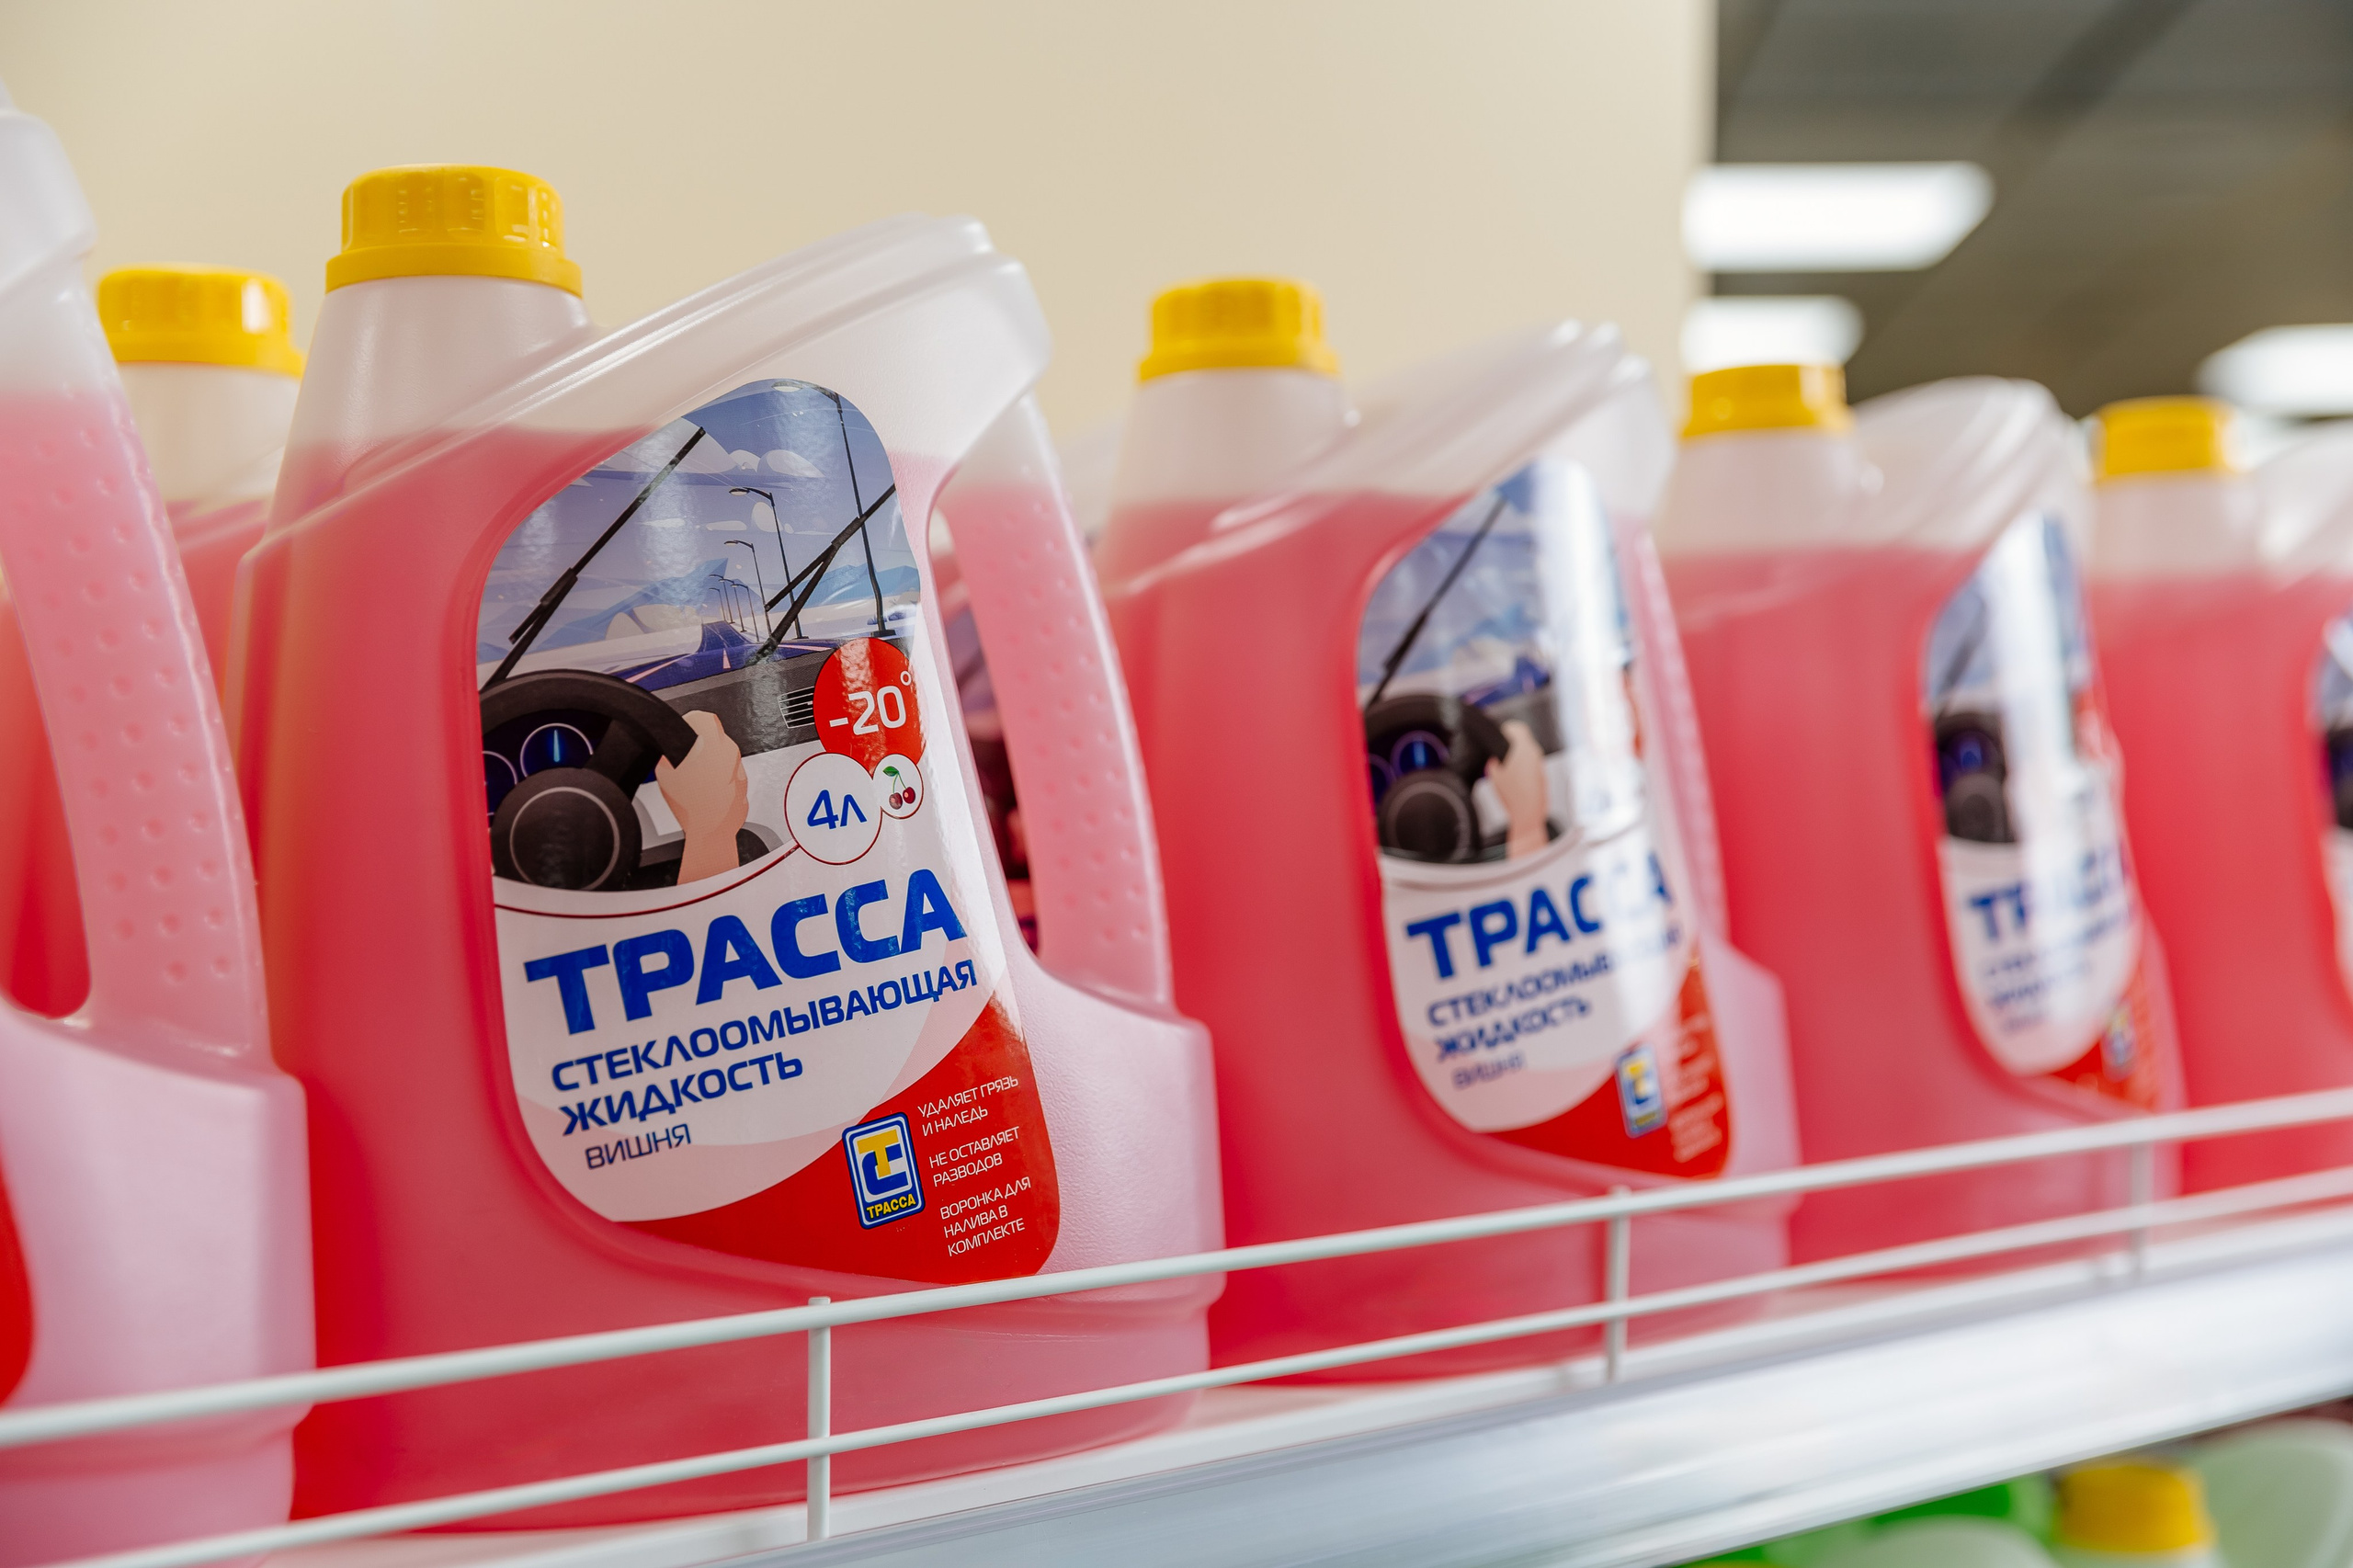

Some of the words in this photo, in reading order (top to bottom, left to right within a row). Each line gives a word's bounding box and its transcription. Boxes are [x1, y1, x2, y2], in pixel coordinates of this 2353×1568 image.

[524, 869, 967, 1035] ТРАССА
[551, 960, 977, 1091] СТЕКЛООМЫВАЮЩАЯ
[561, 1051, 802, 1136] ЖИДКОСТЬ
[917, 1087, 977, 1118] УДАЛЯЕТ
[980, 1074, 1018, 1098] ГРЯЗЬ
[922, 1123, 933, 1137] И
[935, 1106, 988, 1132] НАЛЕДЬ
[585, 1123, 691, 1169] ВИШНЯ
[928, 1151, 949, 1168] НЕ
[949, 1126, 1020, 1157] ОСТАВЛЯЕТ
[933, 1153, 1003, 1187] РАЗВОДОВ
[867, 1193, 916, 1219] ТРАССА
[940, 1187, 1003, 1220] ВОРОНКА
[1004, 1176, 1031, 1199] ДЛЯ
[944, 1209, 998, 1238] НАЛИВА
[998, 1204, 1008, 1219] В
[948, 1218, 1025, 1256] КОМПЛЕКТЕ
